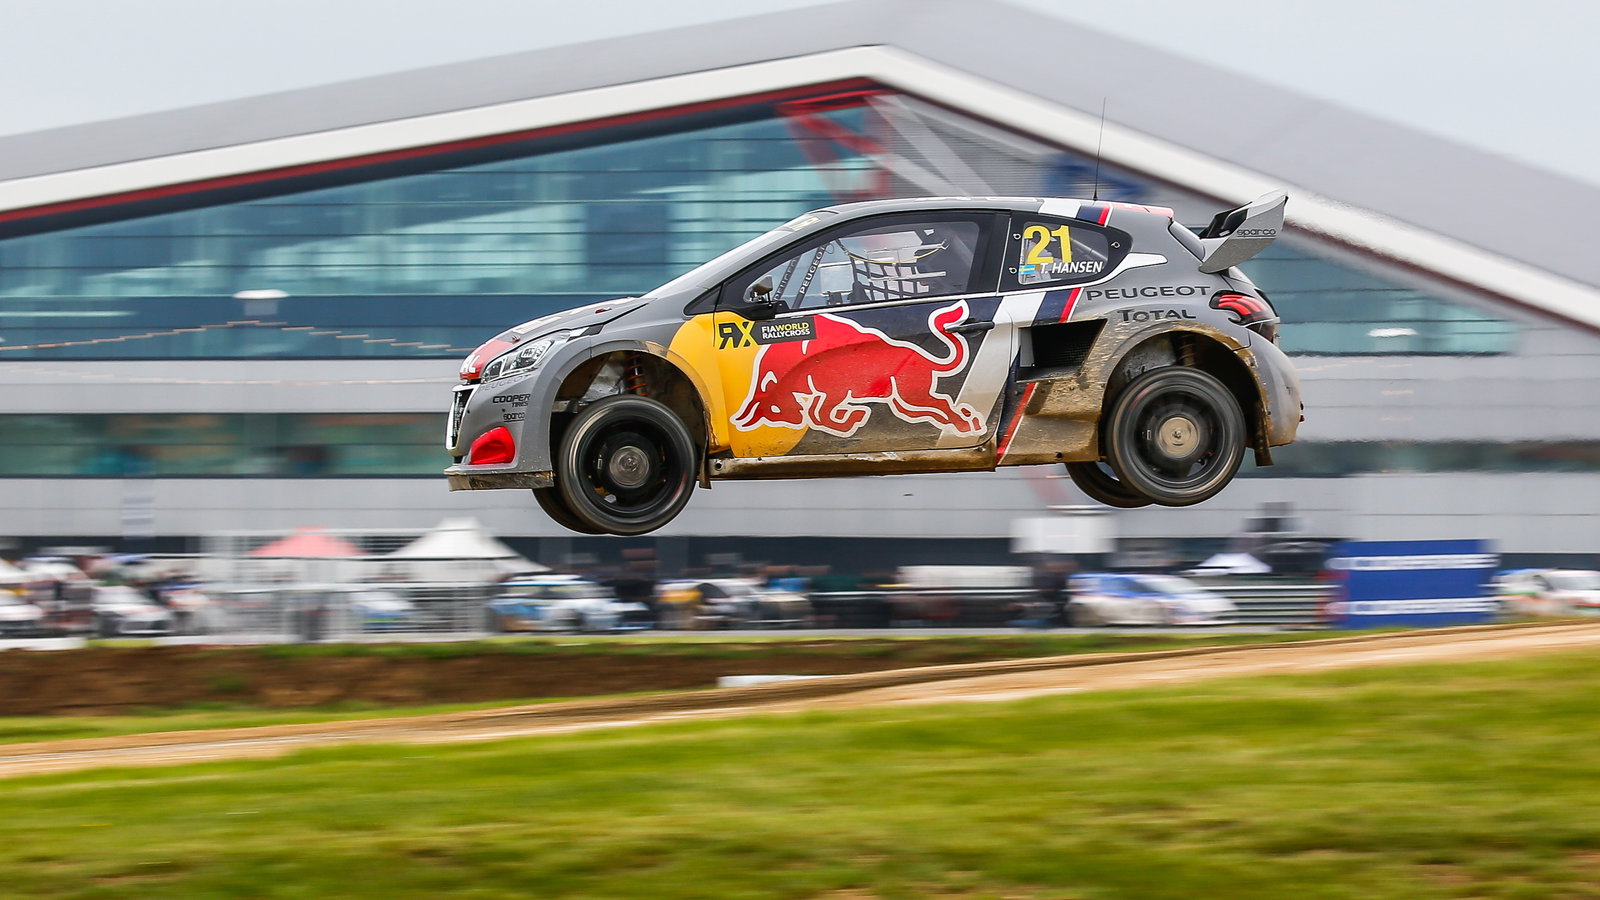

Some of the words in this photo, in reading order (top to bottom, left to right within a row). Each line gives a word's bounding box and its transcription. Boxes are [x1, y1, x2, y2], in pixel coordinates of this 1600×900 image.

[1237, 228, 1276, 238] sparco
[1023, 225, 1072, 265] 21
[1040, 262, 1049, 274] T.
[1051, 261, 1103, 274] HANSEN
[1086, 285, 1211, 301] PEUGEOT
[1117, 309, 1197, 322] TOTAL
[762, 328, 811, 339] RALLYCROSS
[492, 393, 531, 404] COOPER
